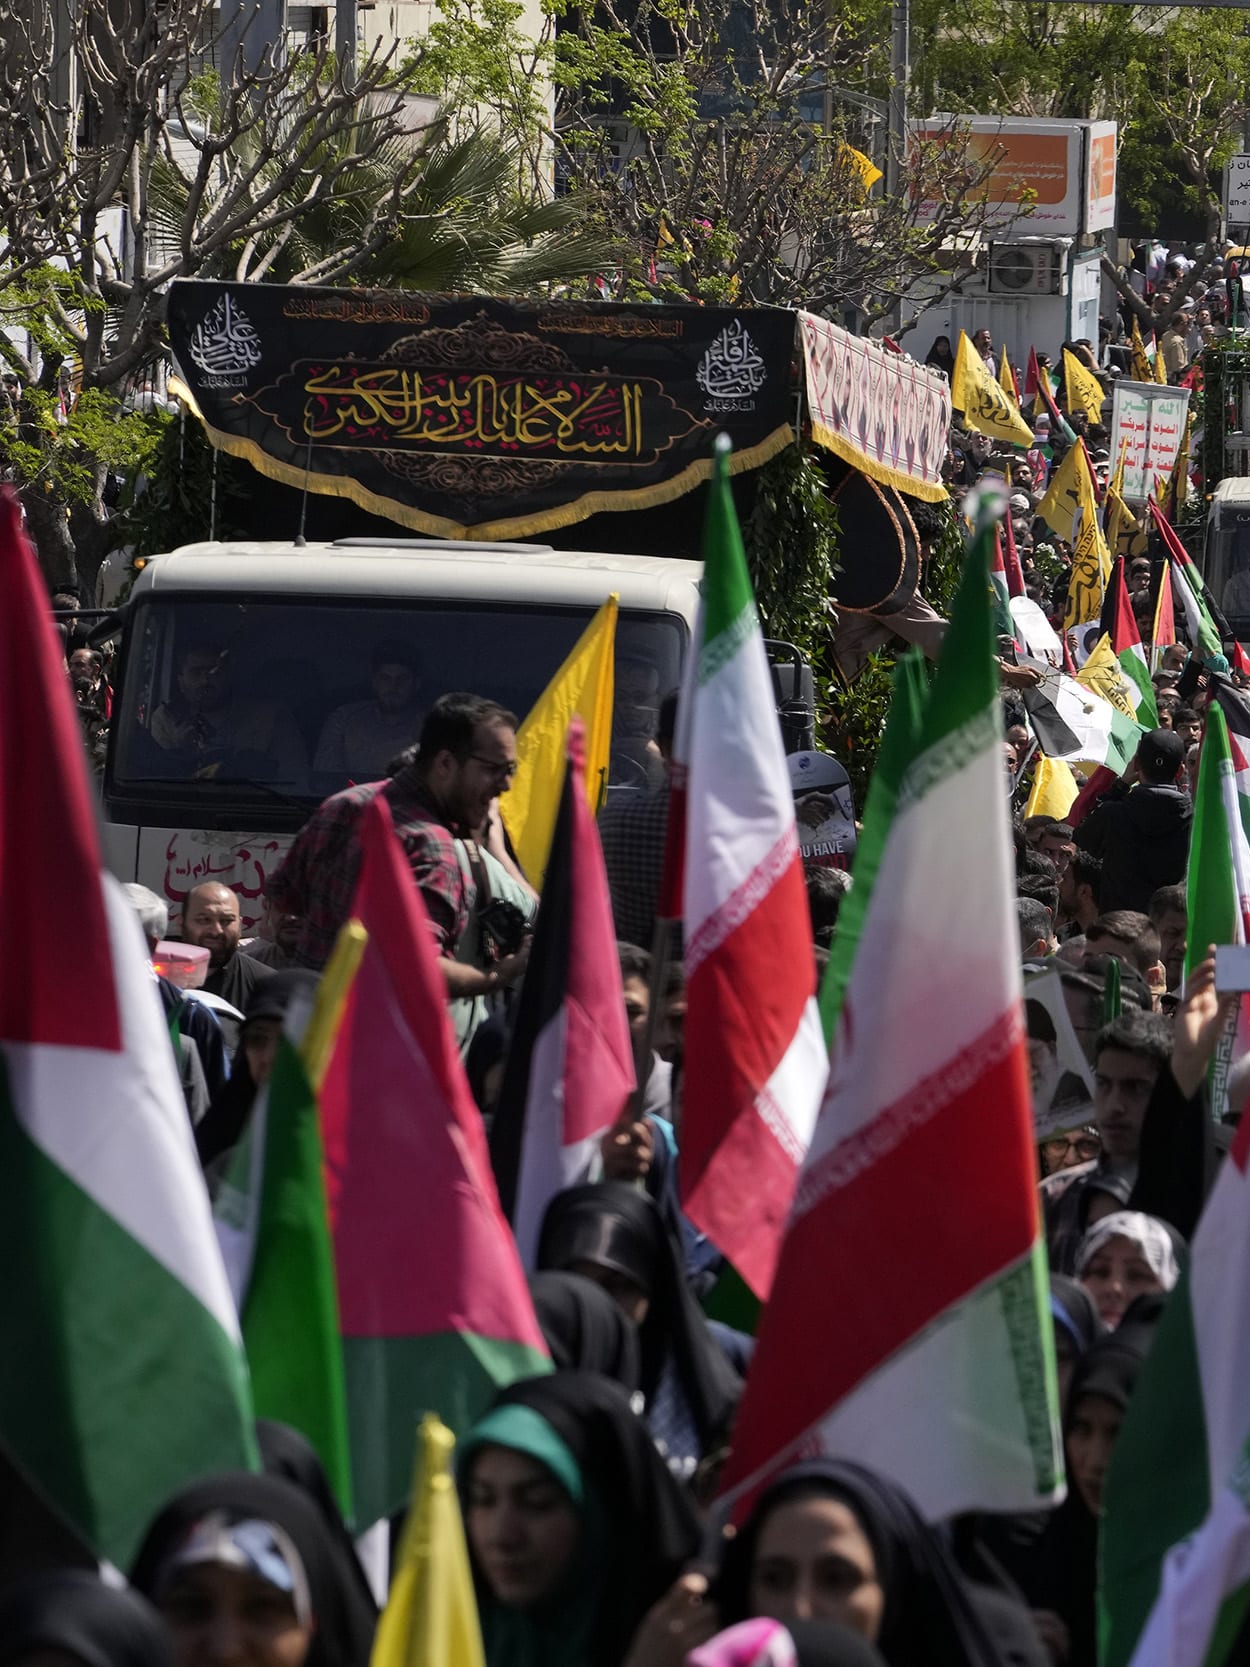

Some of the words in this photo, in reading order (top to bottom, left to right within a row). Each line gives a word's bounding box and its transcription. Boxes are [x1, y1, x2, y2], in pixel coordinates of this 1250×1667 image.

[1121, 399, 1148, 415] كبر
[524, 382, 643, 457] السلام
[814, 840, 844, 856] HAVE
